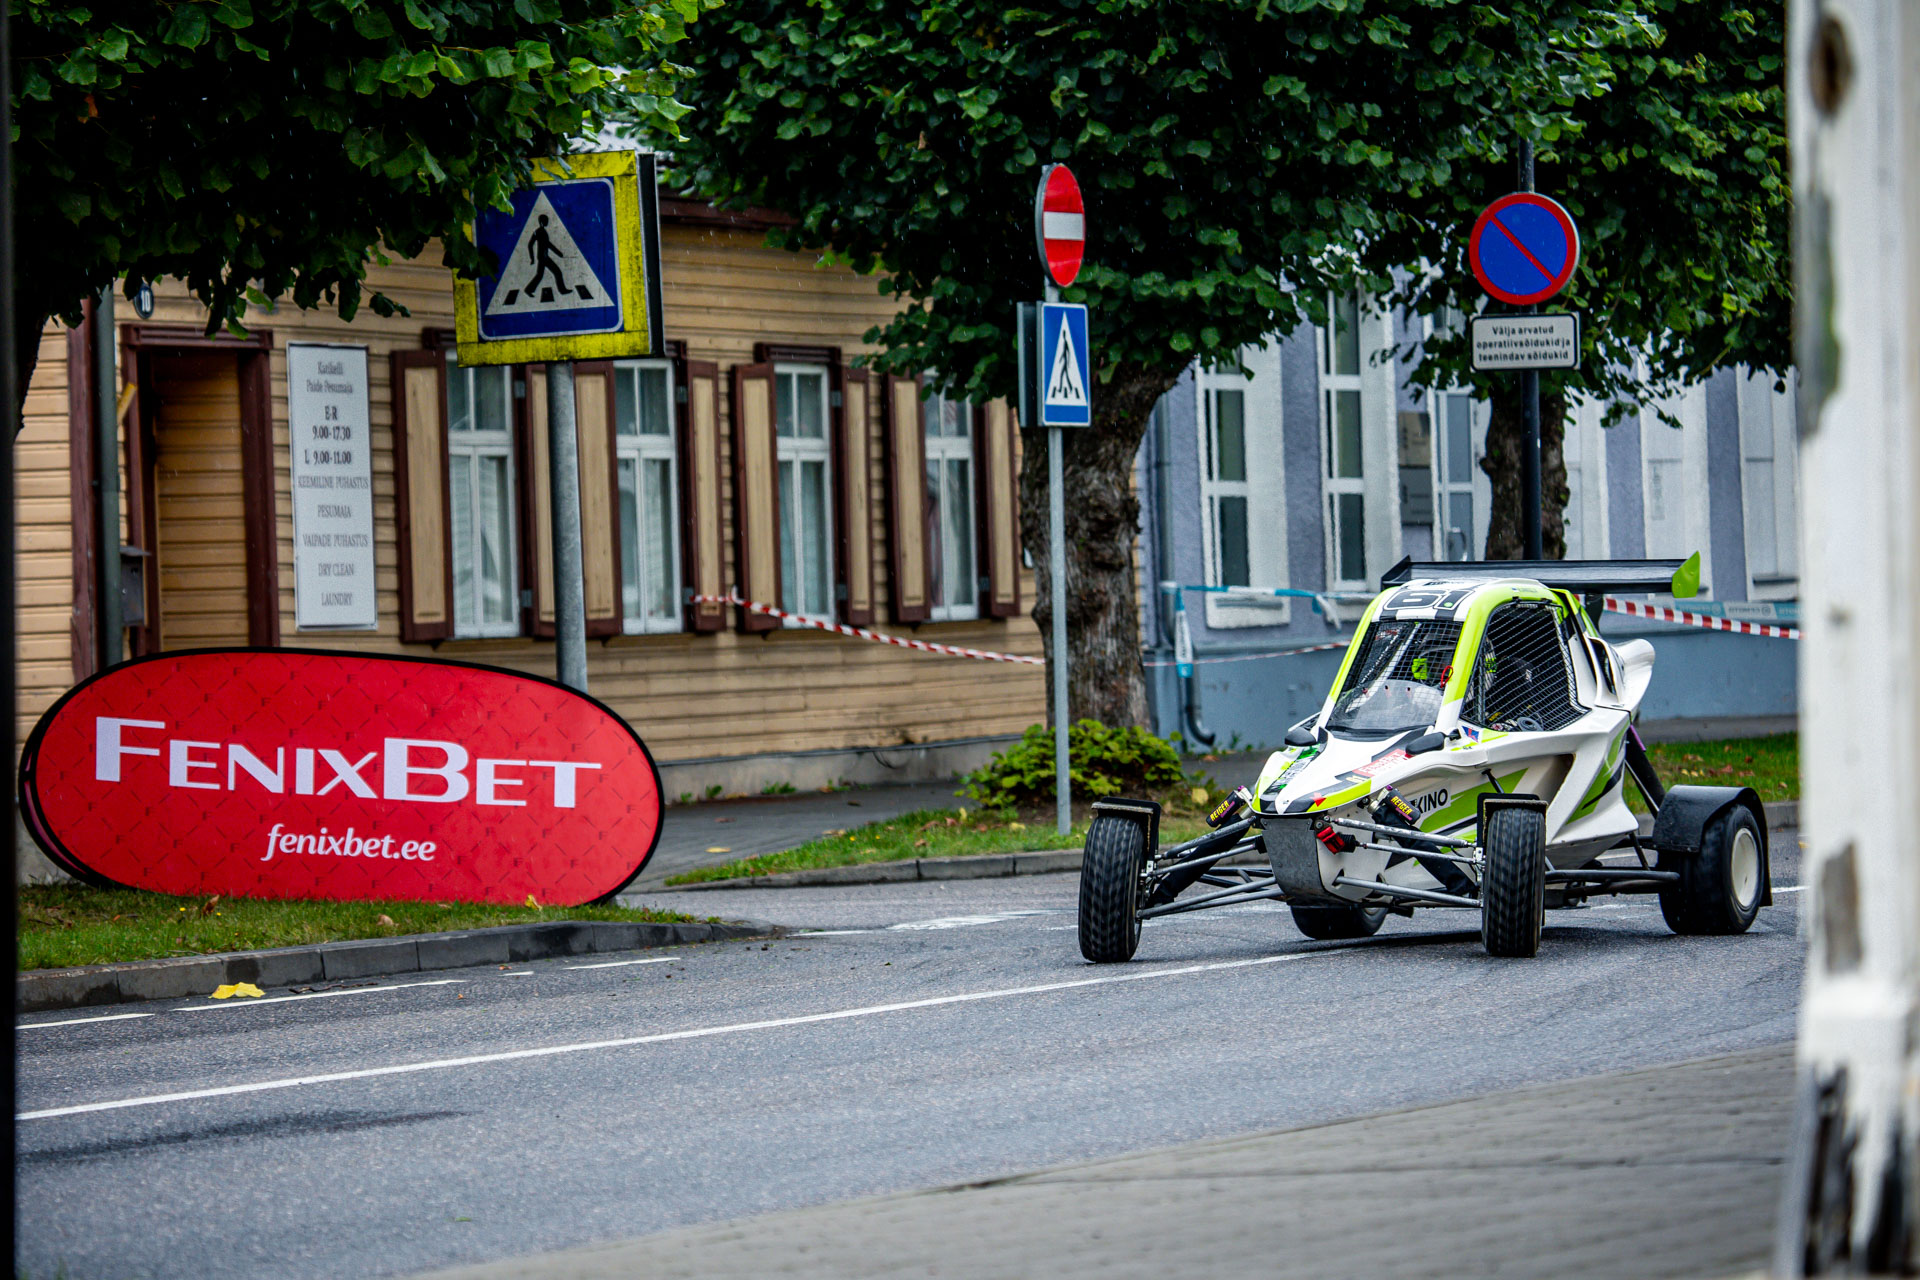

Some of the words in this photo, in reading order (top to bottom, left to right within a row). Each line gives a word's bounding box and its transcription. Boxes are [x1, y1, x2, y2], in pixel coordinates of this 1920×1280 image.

[141, 290, 151, 312] 10
[1492, 325, 1516, 336] Välja
[1518, 325, 1554, 334] arvatud
[1476, 338, 1560, 350] operatiivsõidukid
[1561, 339, 1571, 349] ja
[1478, 352, 1525, 362] teenindav
[1527, 350, 1569, 360] sõidukid
[304, 449, 310, 465] L
[335, 476, 369, 489] PUHASTUS
[333, 534, 369, 548] PUHASTUS
[318, 563, 332, 576] DRY
[333, 563, 355, 576] CLEAN
[321, 592, 353, 606] LAUNDRY
[1209, 800, 1231, 822] REIGER
[1390, 795, 1413, 816] REIGER
[260, 823, 437, 861] fenixbet.ee
